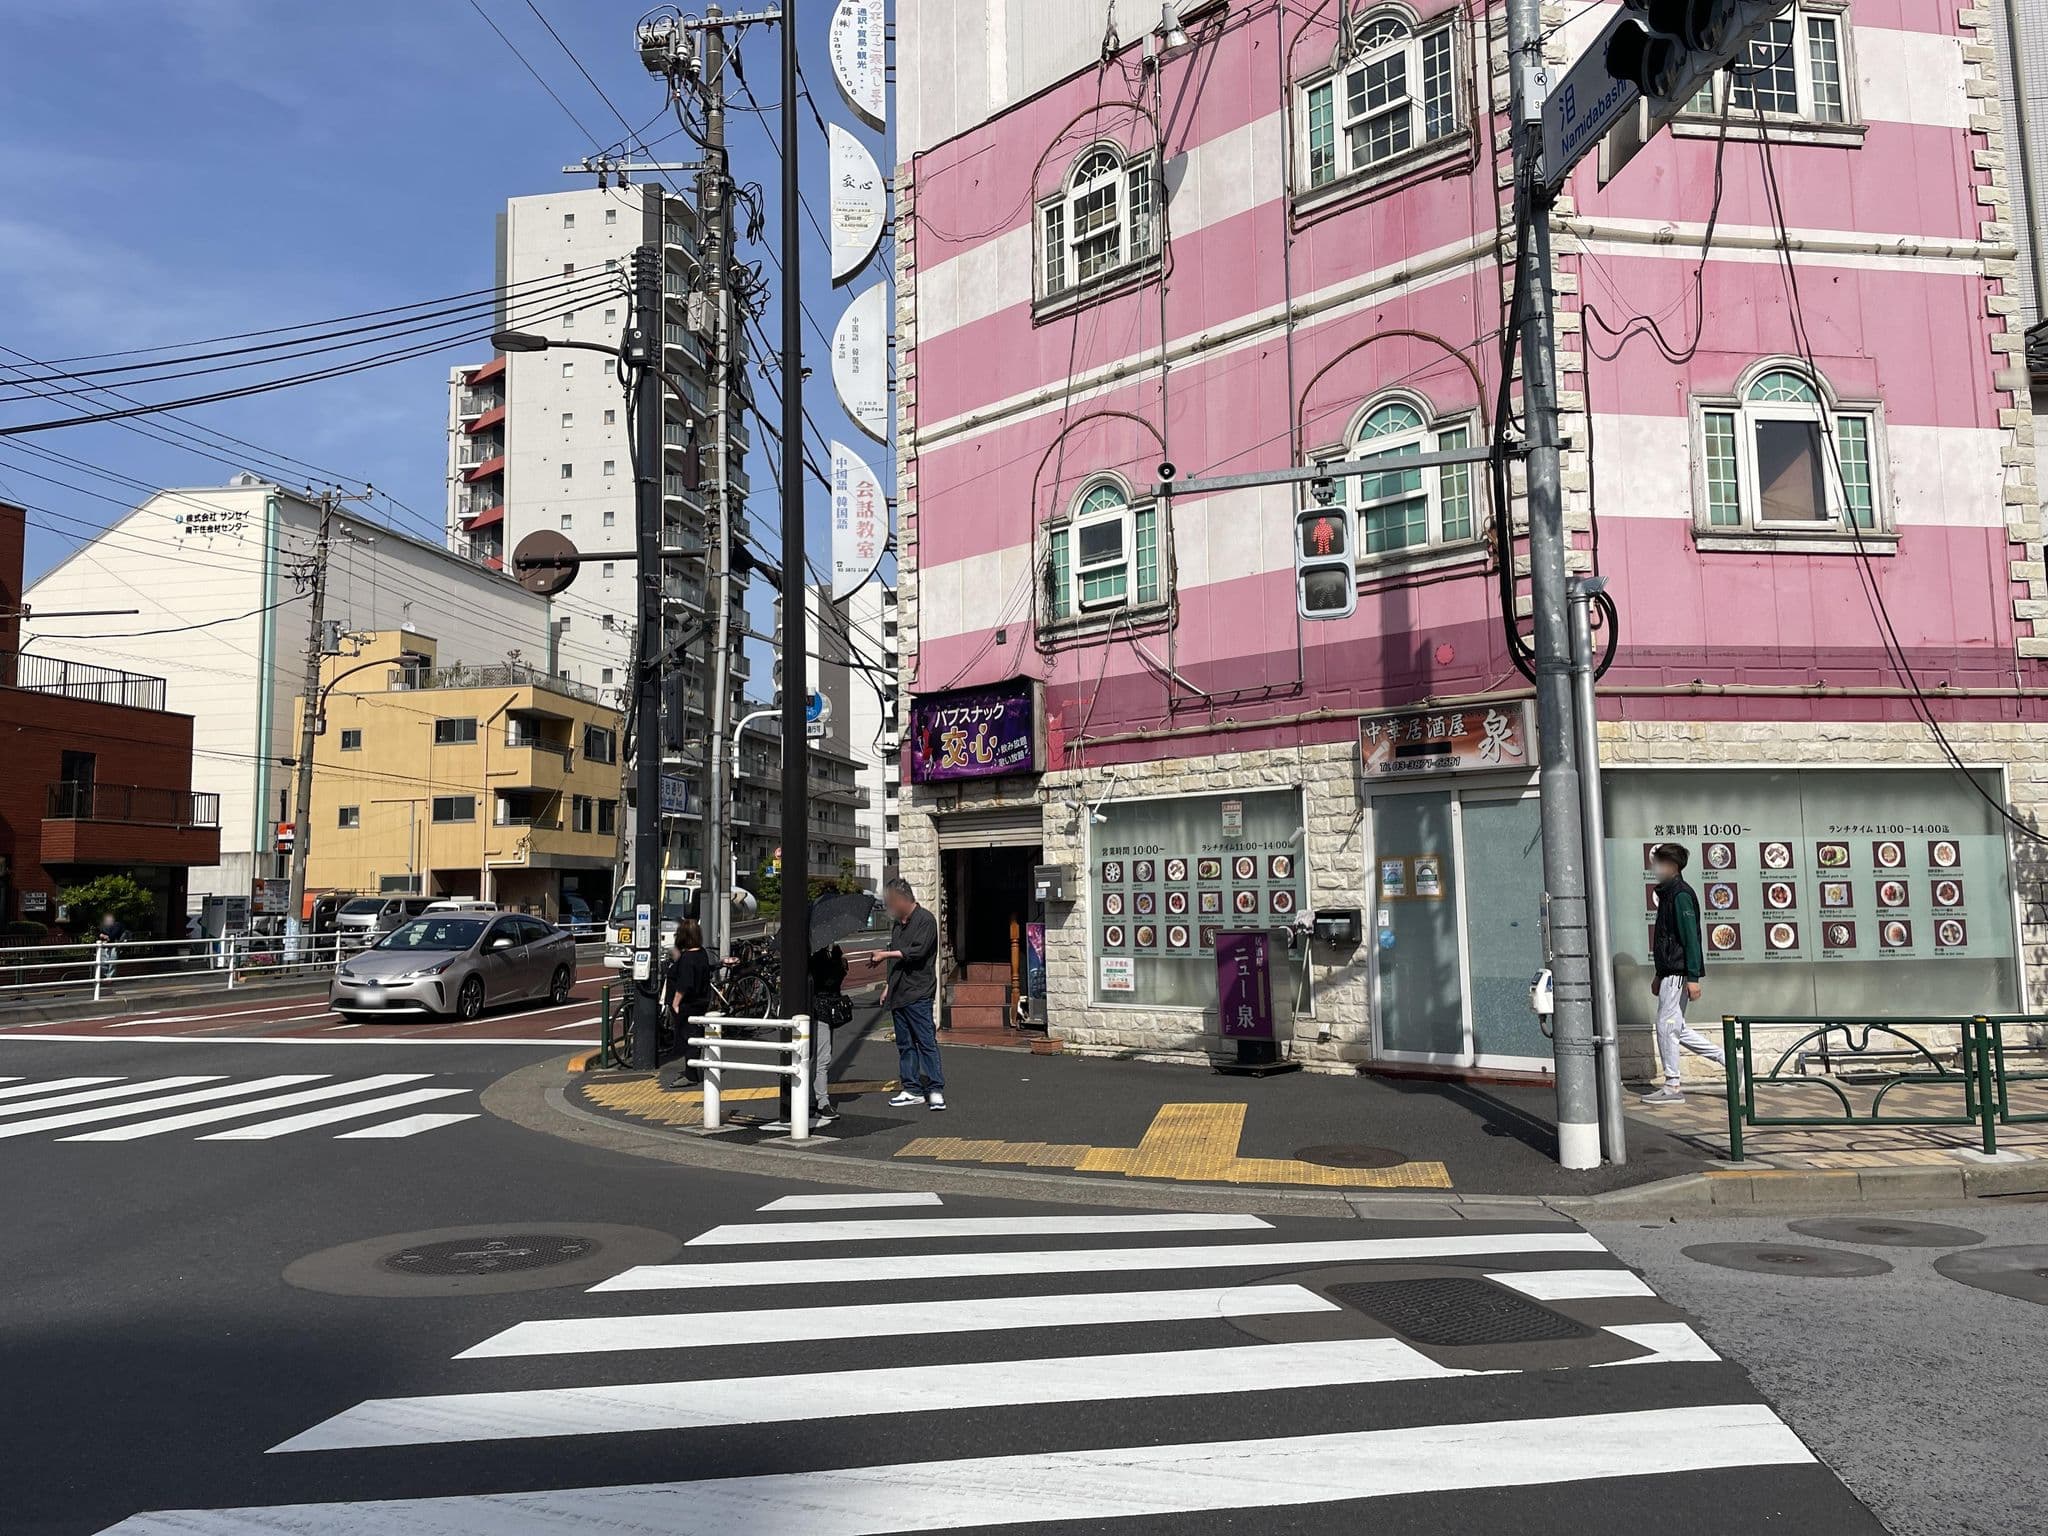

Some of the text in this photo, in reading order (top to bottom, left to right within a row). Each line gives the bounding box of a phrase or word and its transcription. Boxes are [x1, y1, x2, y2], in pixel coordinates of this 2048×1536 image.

[1561, 79, 1628, 157] Namidabashi
[836, 457, 848, 530] 中国語 韓国語
[220, 510, 250, 522] サンセイ
[856, 480, 874, 559] 会話教室
[934, 702, 1005, 728] パブスナック
[1365, 714, 1468, 745] 中華居酒屋
[940, 723, 998, 769] 交心
[1477, 708, 1522, 763] 泉
[1653, 824, 1698, 836] 営業時間
[1828, 824, 1873, 834] ランチタイム
[1101, 847, 1130, 856] 営業時間
[619, 928, 632, 943] 危
[1234, 947, 1255, 1029] ニュー泉
